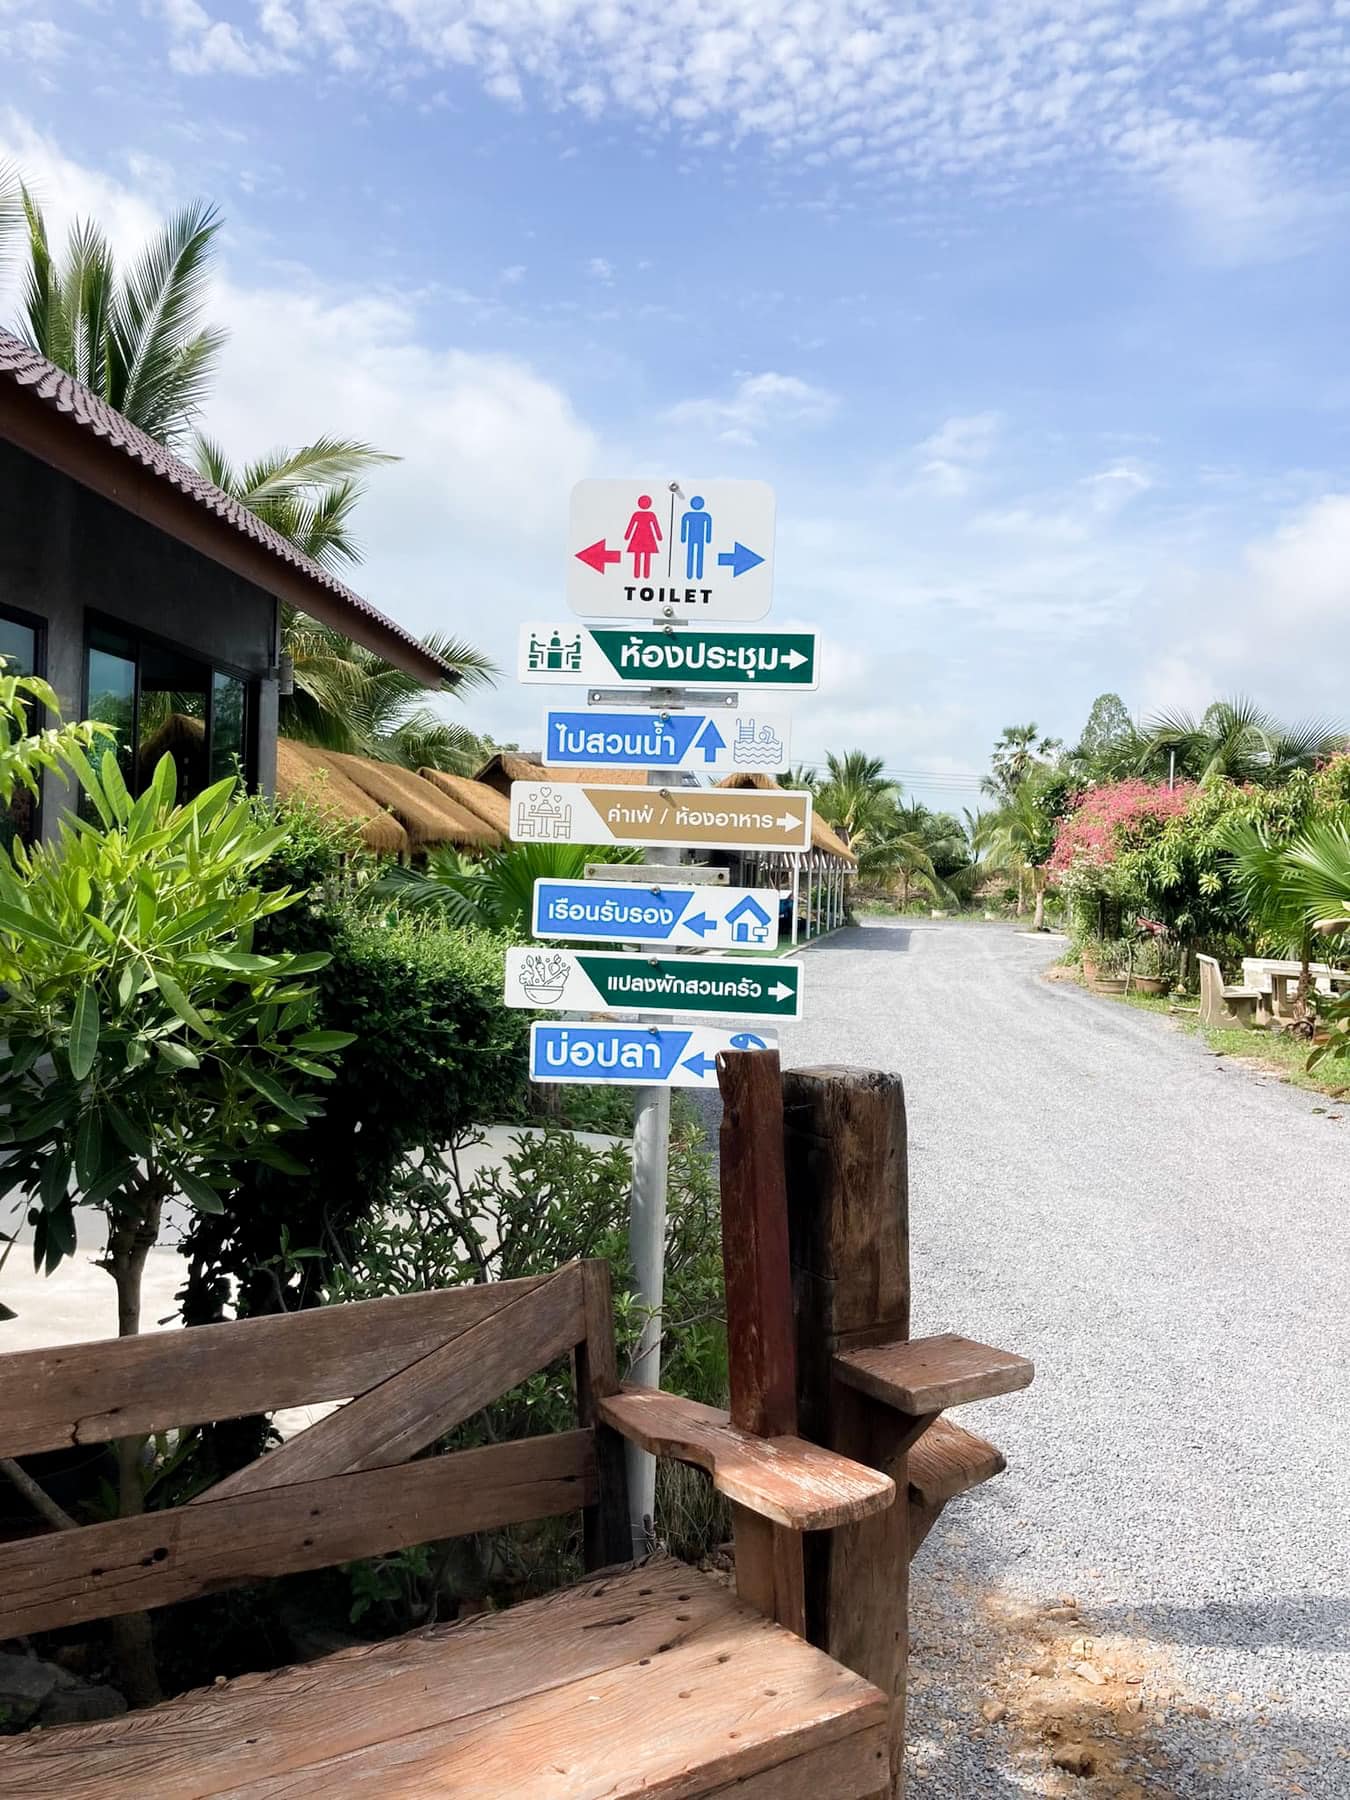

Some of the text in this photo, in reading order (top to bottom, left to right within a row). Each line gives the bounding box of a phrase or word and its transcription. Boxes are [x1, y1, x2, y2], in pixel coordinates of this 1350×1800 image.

[624, 587, 713, 604] TOILET
[620, 637, 779, 680] ห้องประชุม
[555, 721, 676, 757] ไปสวนน้ำ
[675, 806, 774, 829] ห้องอาหาร
[548, 897, 674, 927] เรือนรับรอง
[607, 973, 763, 999] แปลงผักสวนครัว
[546, 1031, 661, 1069] บ่อปลา
